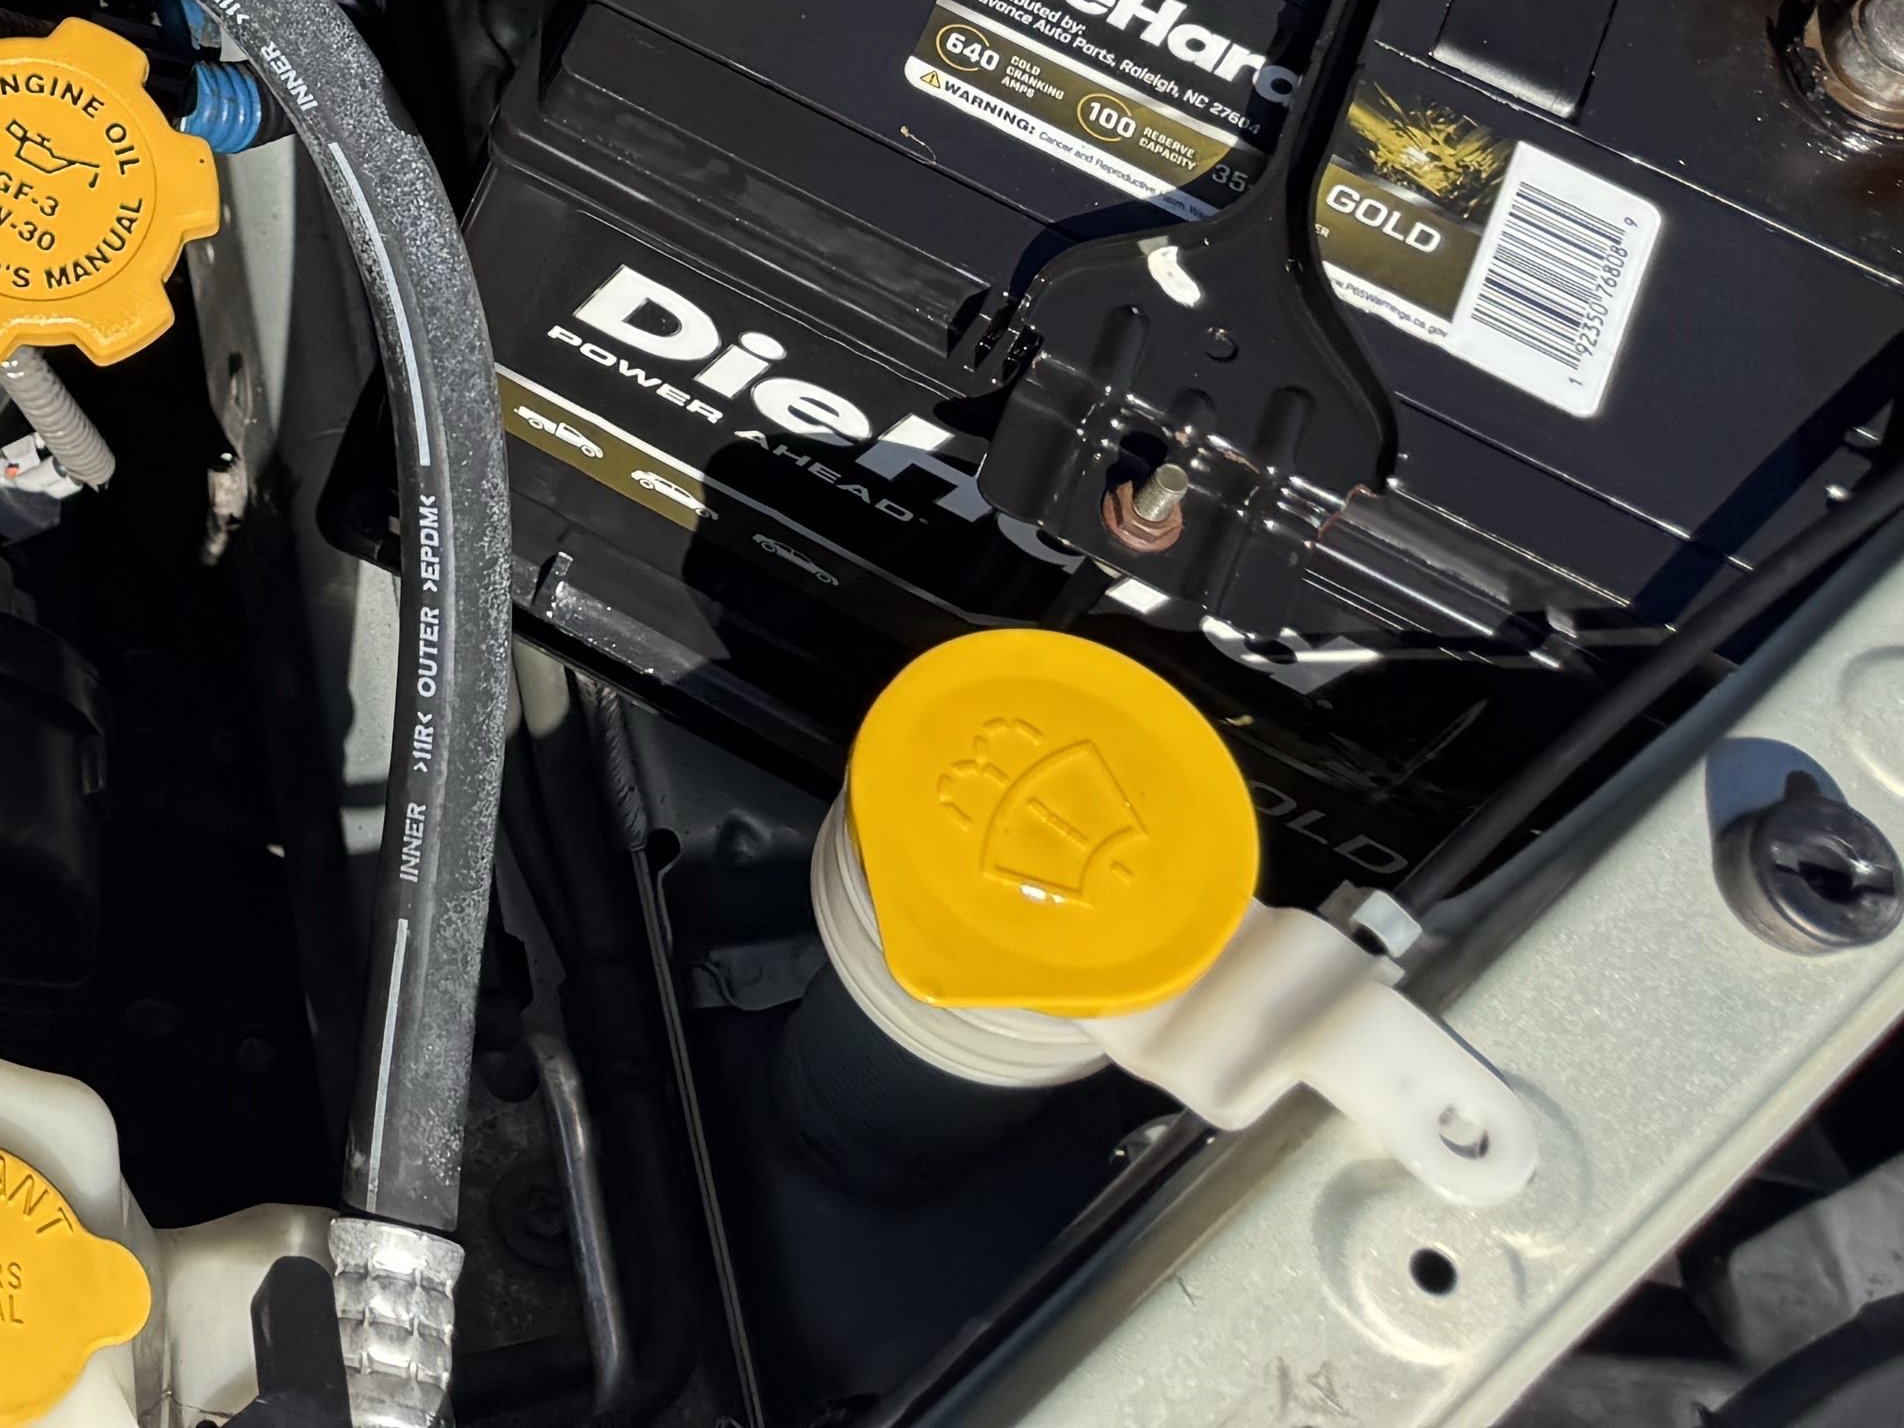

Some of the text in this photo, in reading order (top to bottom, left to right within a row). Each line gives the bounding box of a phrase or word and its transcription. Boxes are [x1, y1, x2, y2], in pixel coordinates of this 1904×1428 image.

[945, 32, 1000, 72] 640
[1060, 10, 1087, 36] by:
[260, 41, 319, 112] INNER
[944, 80, 1037, 136] WARNING:
[1006, 65, 1065, 101] CRANKING
[1032, 15, 1072, 46] Auto
[1073, 34, 1117, 68] Parts,
[1119, 58, 1180, 99] Raleigh,
[1184, 87, 1208, 111] NC
[1209, 100, 1261, 136] 27604
[104, 122, 141, 176] OIL
[1088, 101, 1137, 139] 100
[1139, 136, 1199, 173] CAPACITY
[1142, 126, 1197, 158] RESERVE
[44, 197, 144, 290] MANUAL
[1326, 183, 1442, 254] GOLD
[1575, 304, 1610, 357] 92350
[1599, 245, 1630, 299] 76808
[1624, 216, 1639, 230] 9
[547, 325, 918, 524] POWER AHEAD
[420, 494, 440, 593] >EPDM<
[417, 605, 440, 700] OUTER
[399, 801, 428, 885] INNER
